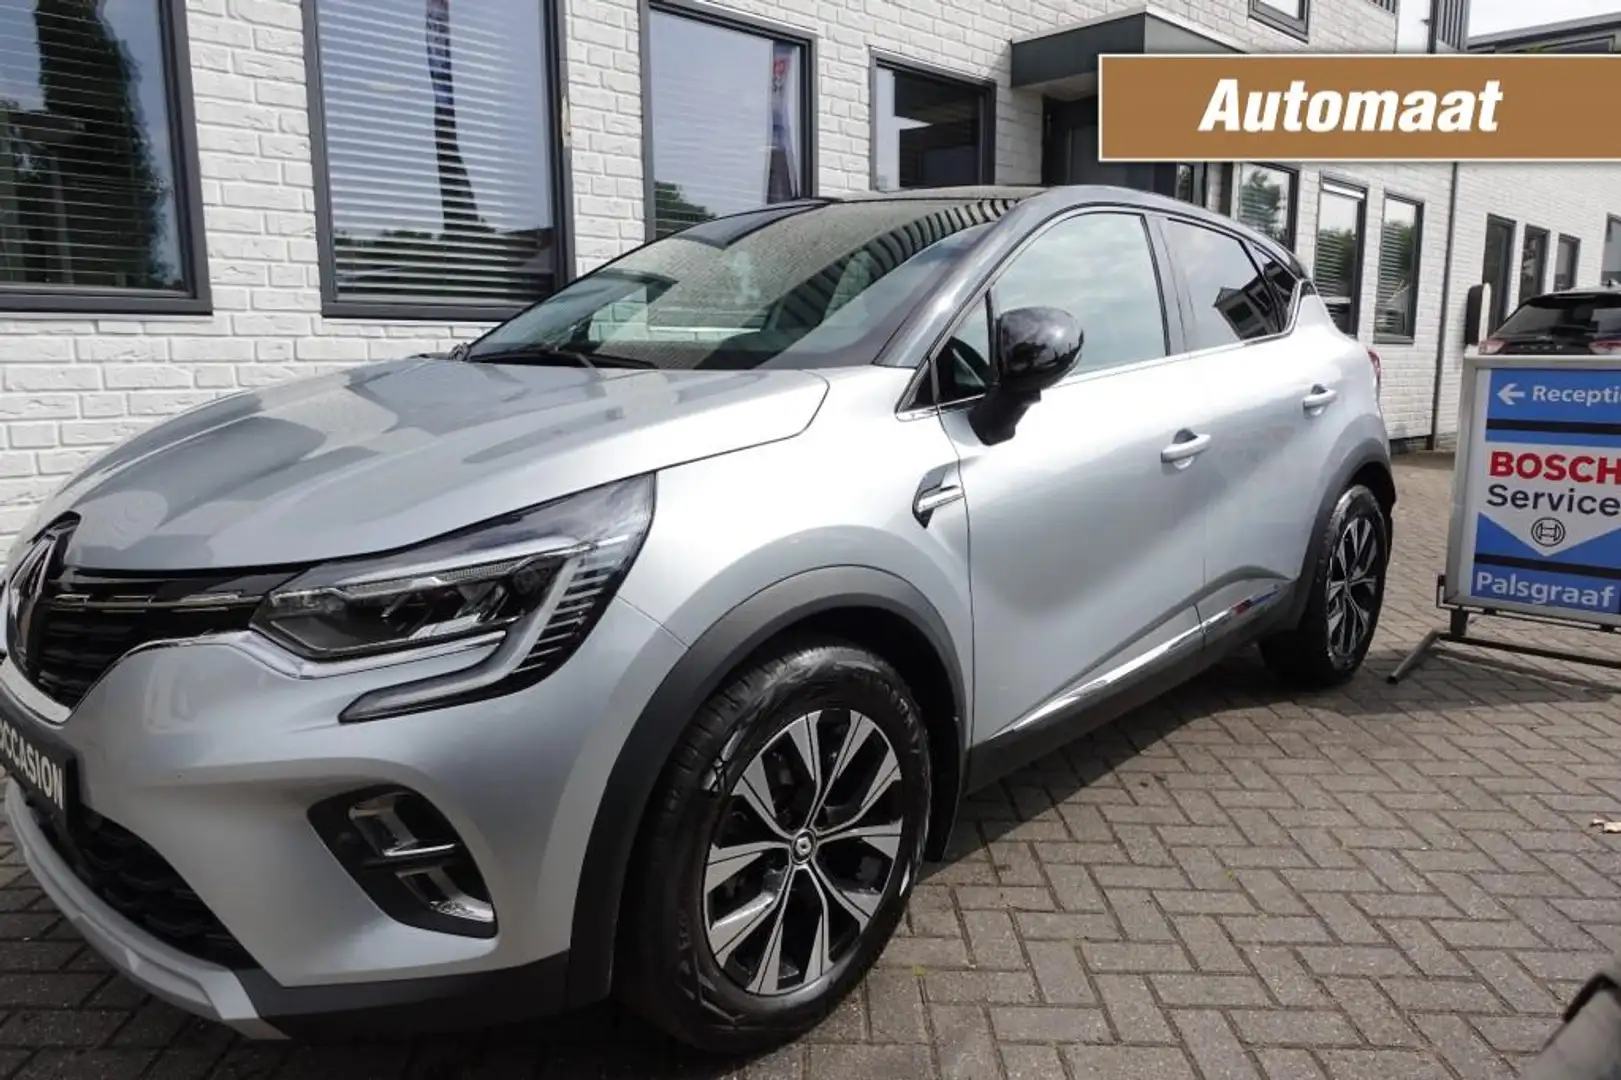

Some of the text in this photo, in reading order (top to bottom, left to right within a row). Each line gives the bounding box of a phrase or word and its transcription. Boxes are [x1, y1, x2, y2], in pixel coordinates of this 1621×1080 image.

[1532, 384, 1621, 407] Recepti
[1488, 451, 1621, 485] BOSCH
[1486, 484, 1621, 516] Service
[1476, 571, 1615, 607] Palsgraaf
